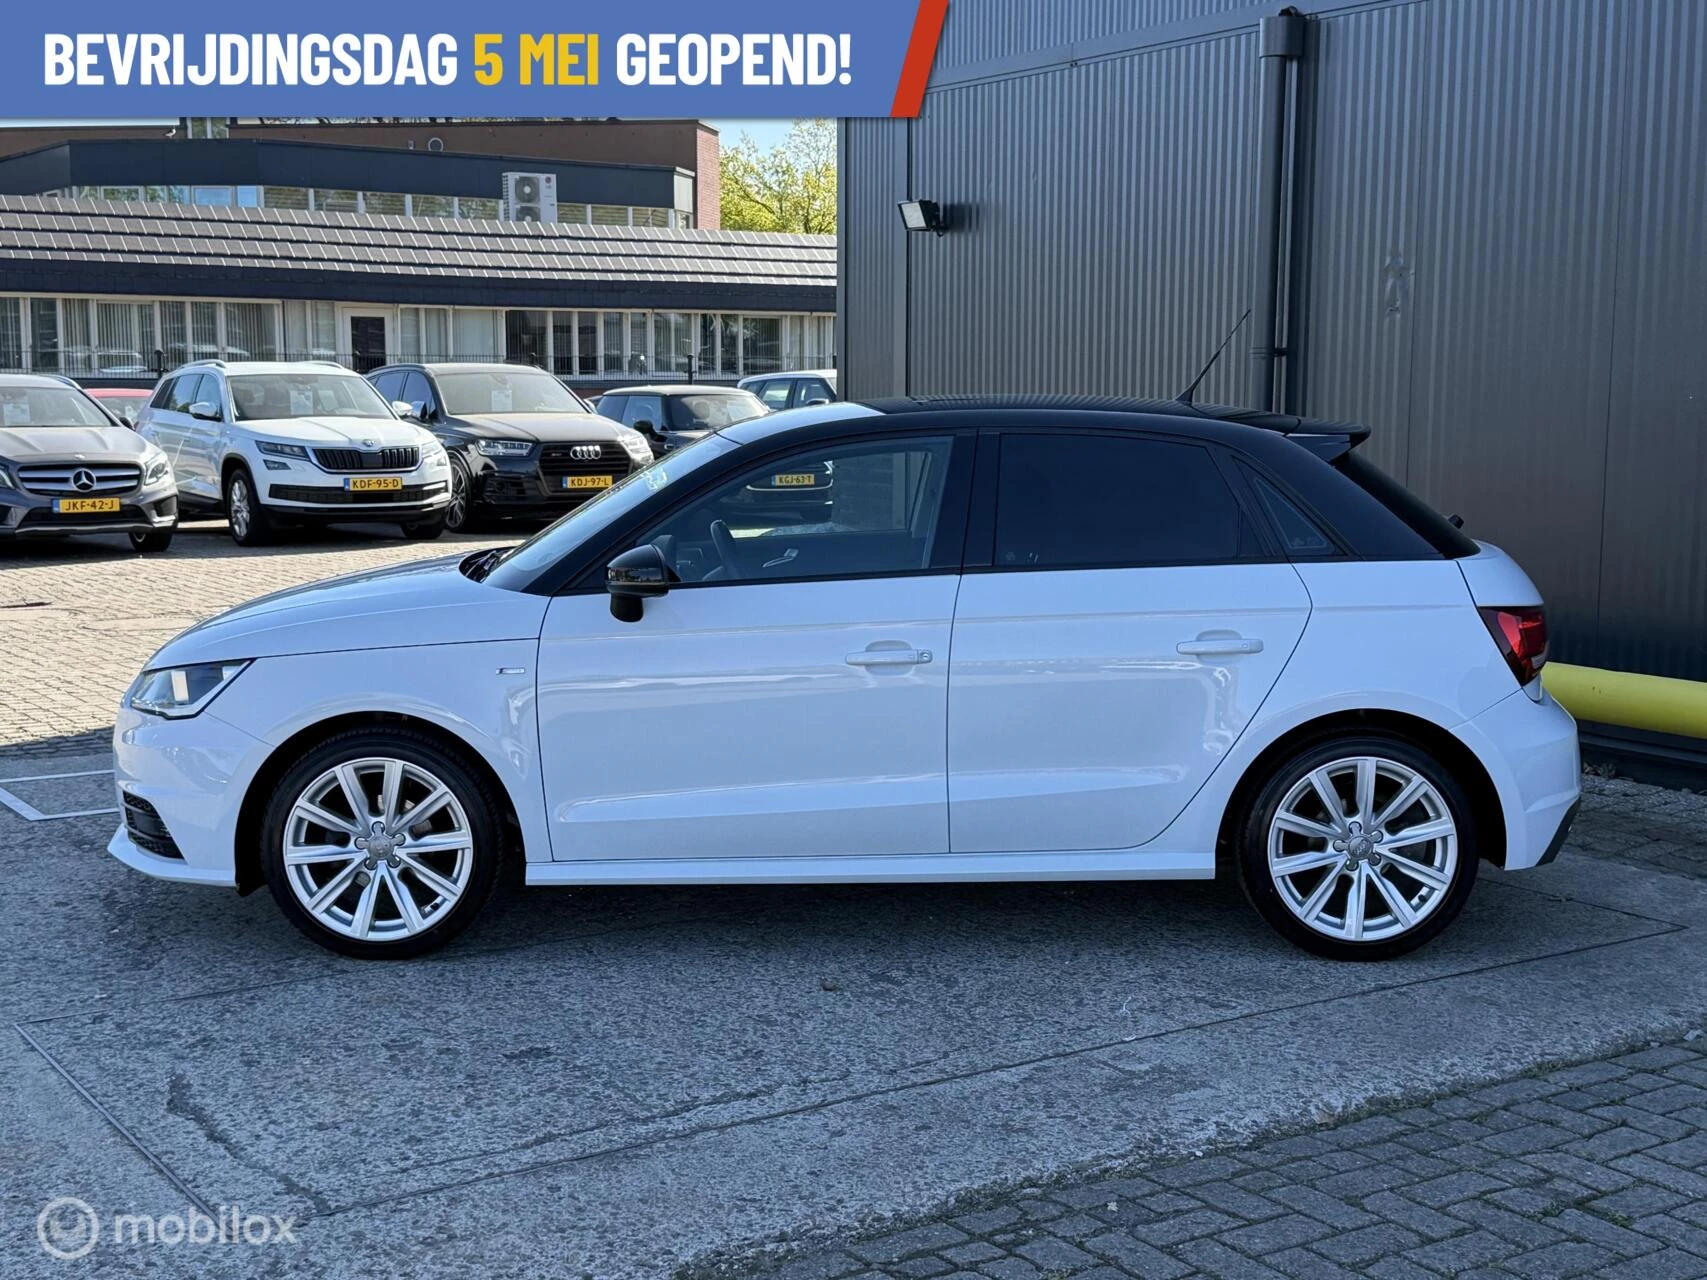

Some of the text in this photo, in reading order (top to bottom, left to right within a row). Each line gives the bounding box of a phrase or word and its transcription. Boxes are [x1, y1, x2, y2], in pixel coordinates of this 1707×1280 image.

[352, 478, 399, 489] KDF-95-D
[570, 477, 610, 487] KDJ-97-L
[65, 499, 115, 511] JKF-42-J
